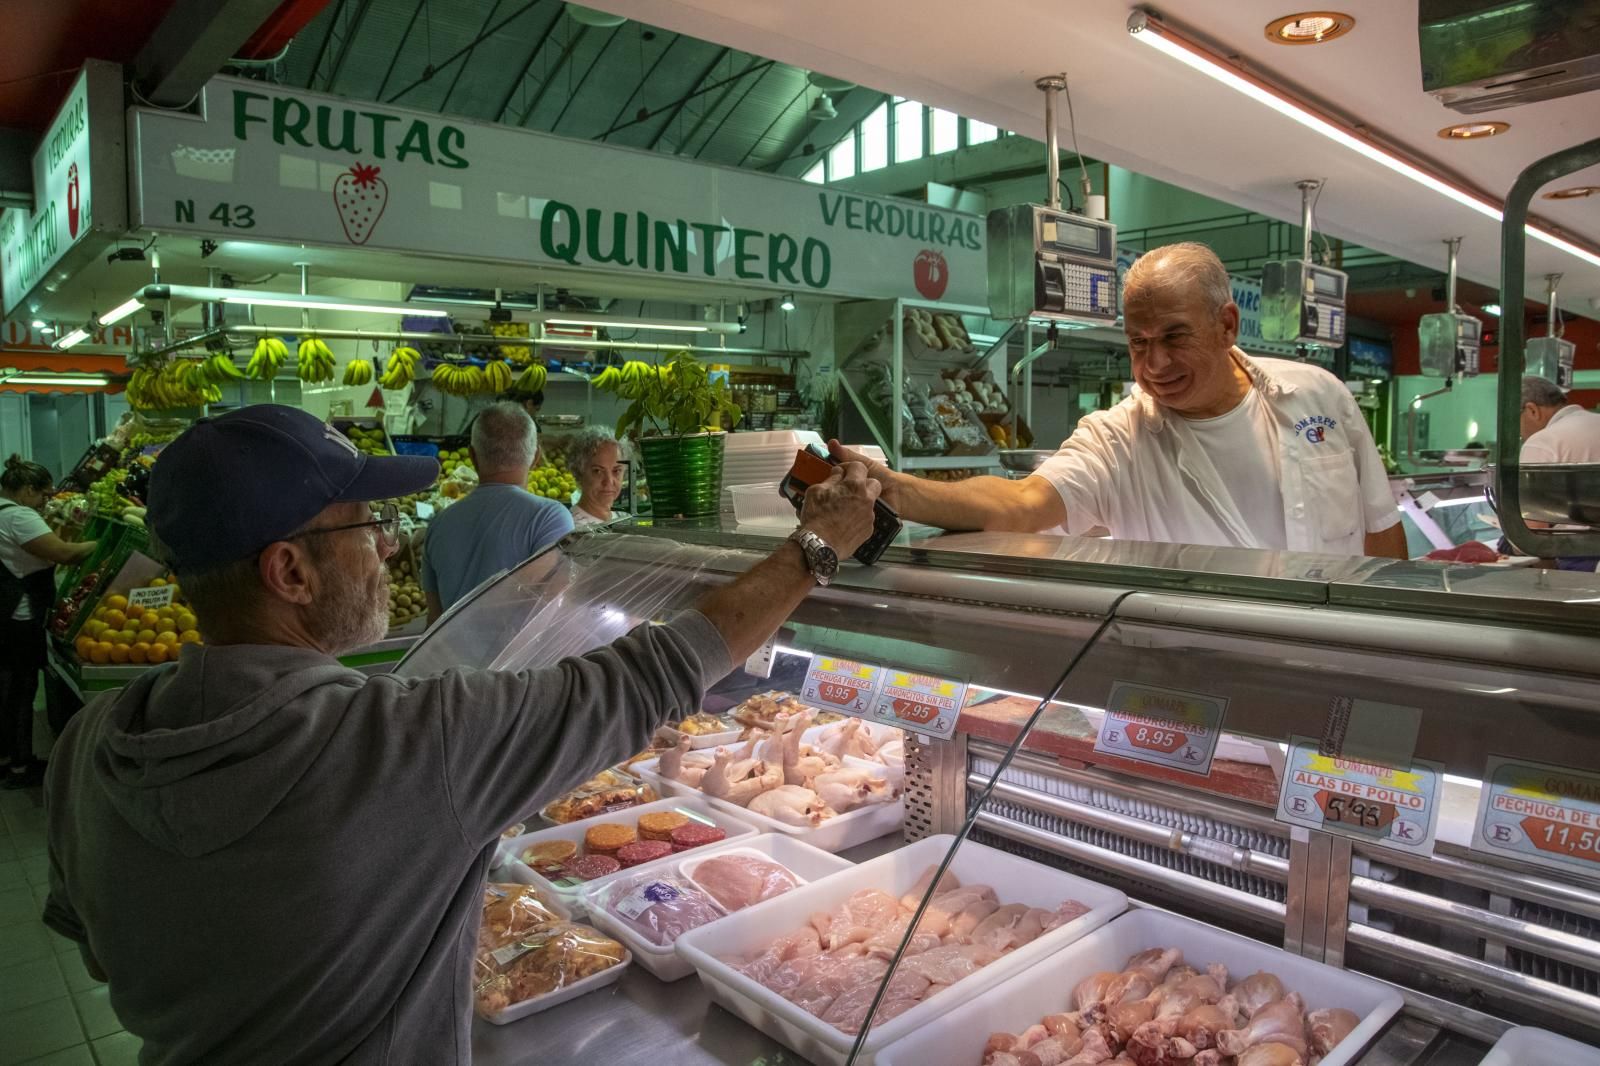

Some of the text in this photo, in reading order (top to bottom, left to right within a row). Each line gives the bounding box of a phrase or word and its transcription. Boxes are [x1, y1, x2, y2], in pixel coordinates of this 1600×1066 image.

[232, 89, 470, 169] FRUTAS
[175, 199, 256, 230] N 43
[818, 191, 983, 251] VERDURAS
[540, 199, 832, 290] QUINTERO
[806, 688, 815, 698] E
[878, 704, 888, 715] E
[1110, 709, 1206, 736] HAMBURGUESAS
[1108, 730, 1119, 742] E
[1135, 727, 1175, 747] 8,95
[1295, 771, 1422, 808] ALAS DE POLLO
[1292, 797, 1307, 813] E
[1496, 795, 1566, 820] PECHUGA
[1570, 810, 1592, 826] DE
[1492, 824, 1512, 842] E
